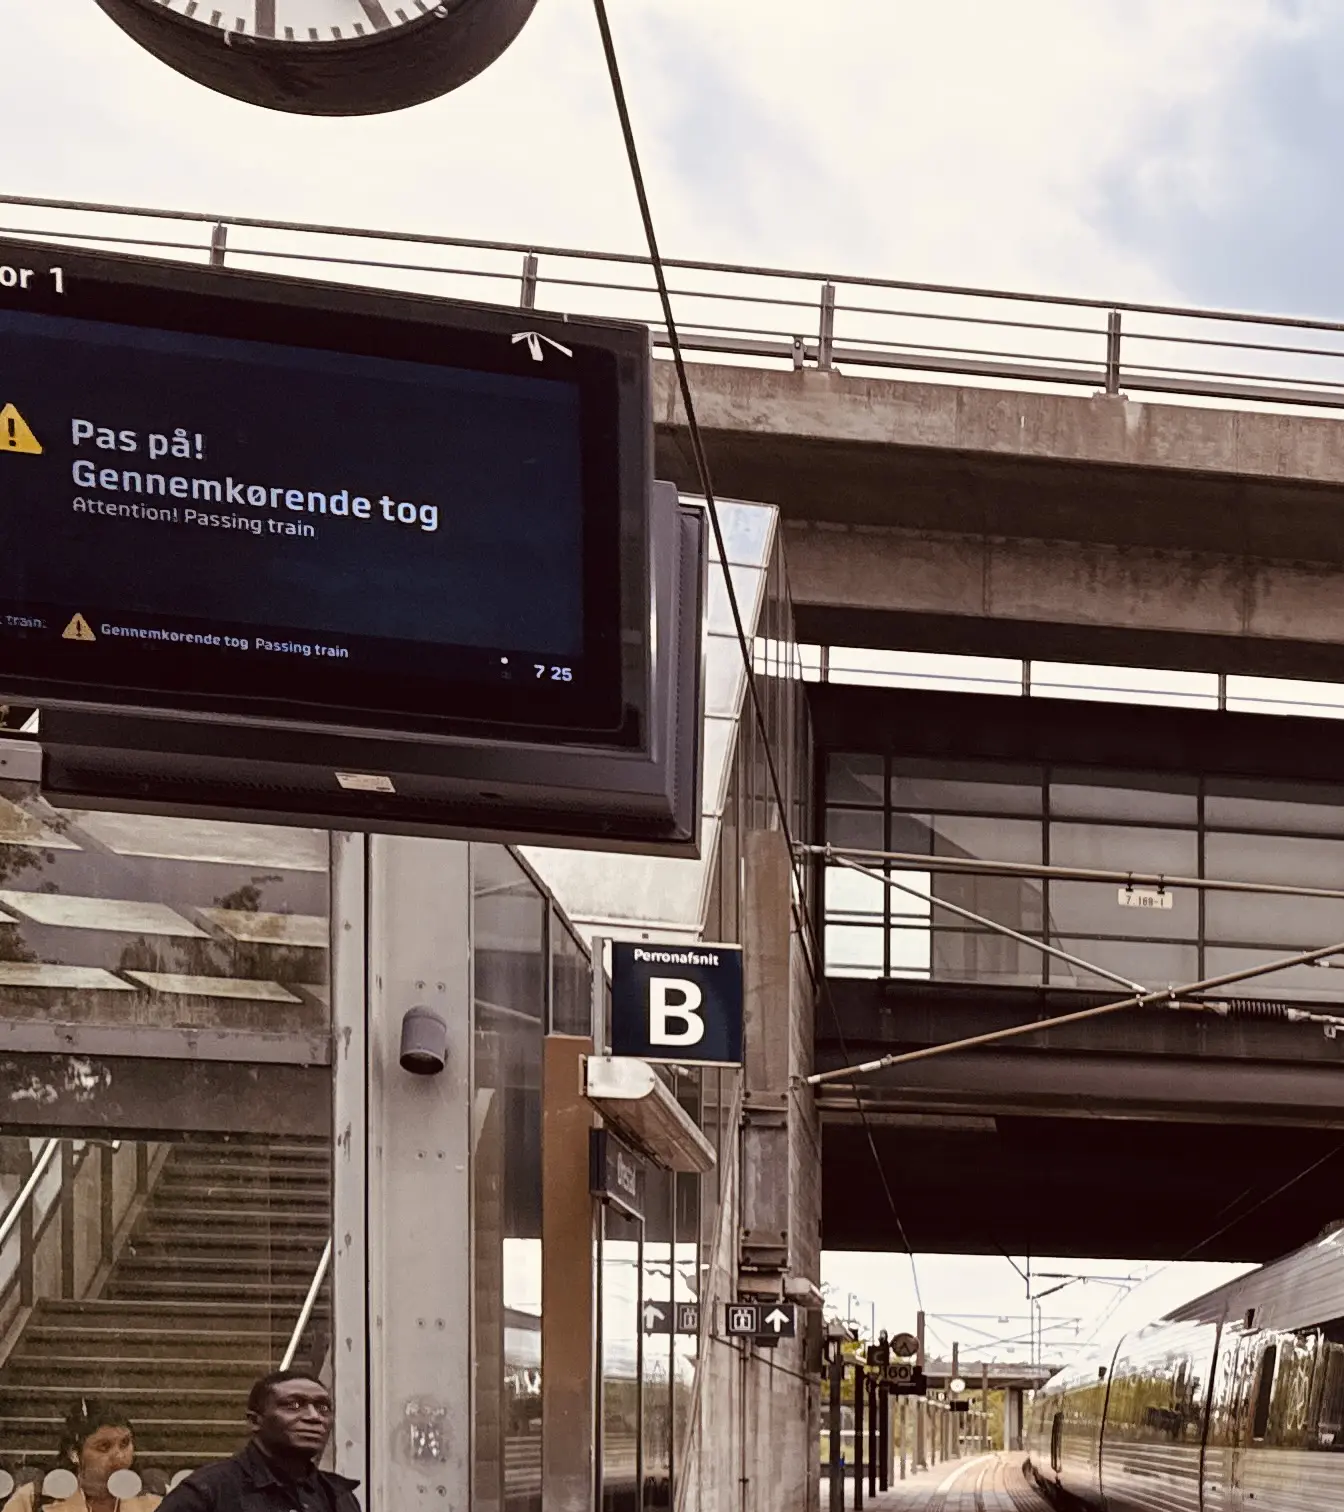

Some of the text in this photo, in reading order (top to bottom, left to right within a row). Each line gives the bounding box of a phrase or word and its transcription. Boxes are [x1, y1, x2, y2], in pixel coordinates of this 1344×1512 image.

[50, 267, 63, 293] 1
[72, 419, 203, 460] Pas på!
[72, 460, 438, 532] Gennemkørende tog
[73, 497, 315, 537] Attention! Passing train
[224, 636, 249, 650] tog
[255, 637, 311, 656] Passing
[315, 644, 349, 658] train
[634, 948, 719, 966] Perronafsnit
[649, 976, 704, 1046] B
